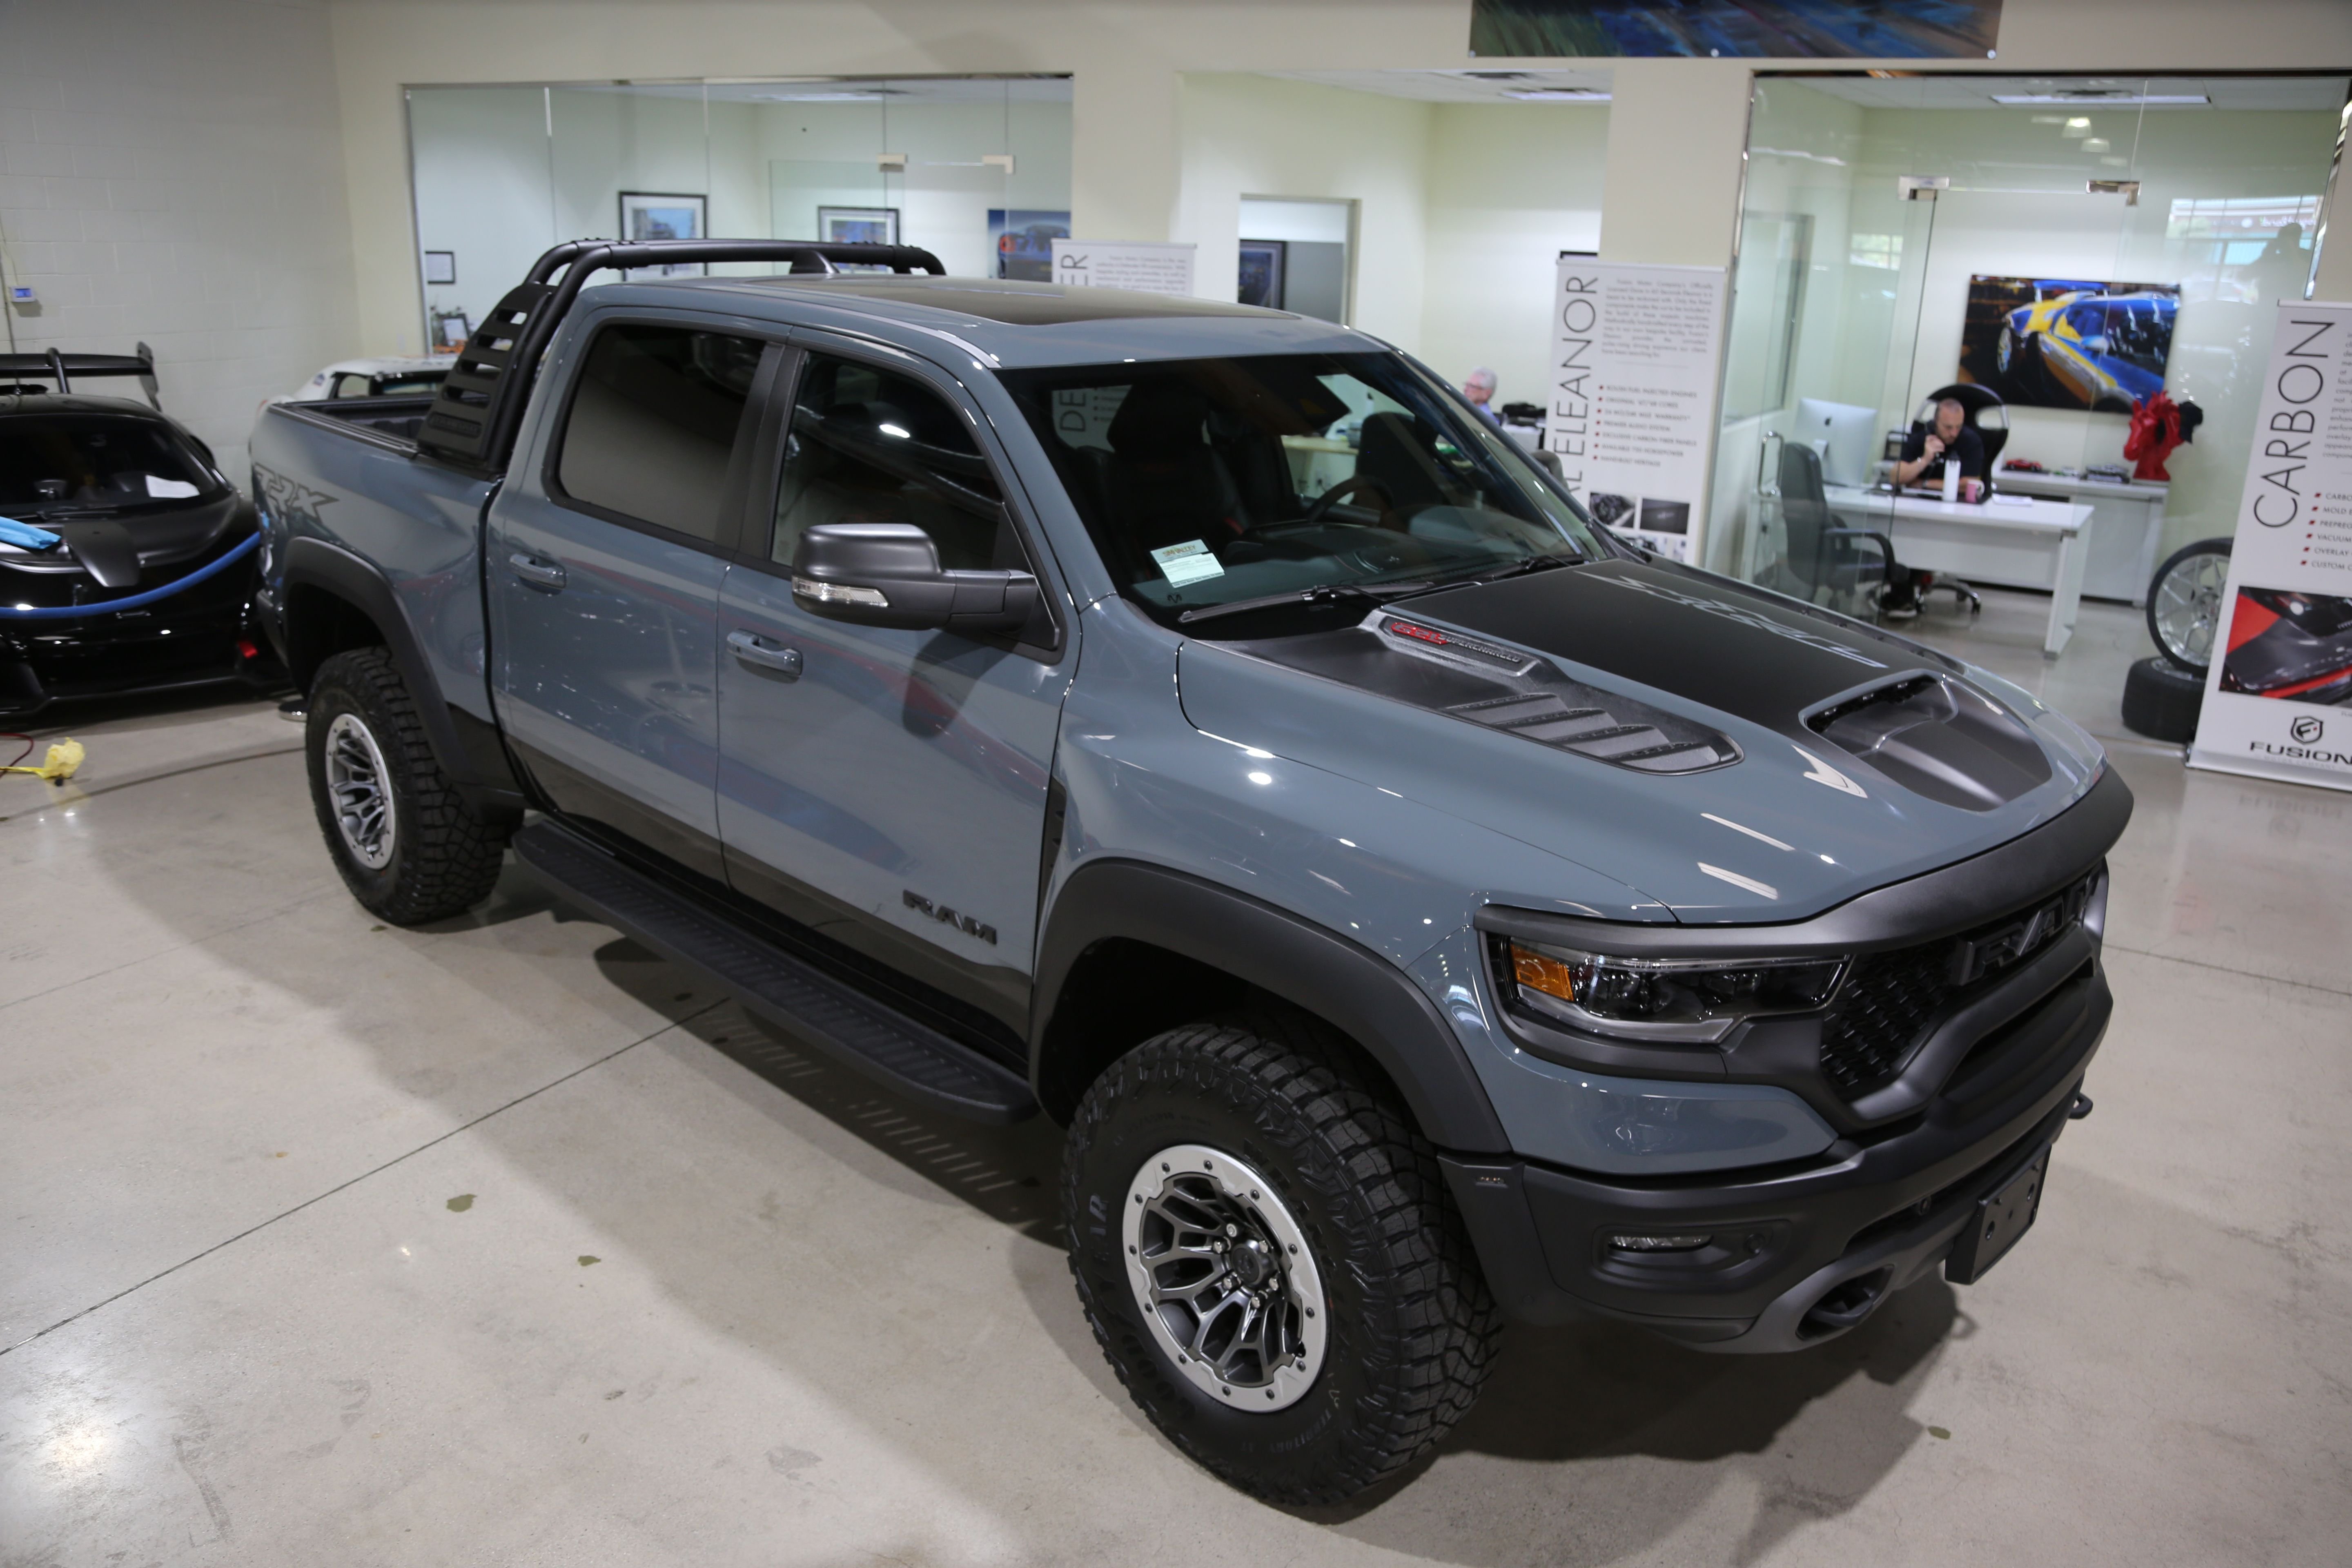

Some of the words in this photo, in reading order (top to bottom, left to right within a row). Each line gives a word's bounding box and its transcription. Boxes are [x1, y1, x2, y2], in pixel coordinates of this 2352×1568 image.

[1555, 277, 1598, 455] ELEANOR
[2253, 320, 2335, 528] CARBON
[2323, 506, 2347, 515] MOLD
[2317, 533, 2352, 543] VACUUM
[1174, 545, 1196, 554] VALLEY
[2314, 547, 2349, 556] OVERLAY
[2312, 560, 2345, 570] CUSTOM
[1437, 634, 1523, 664] SUPERCHARGED
[2250, 742, 2352, 764] FUSION
[903, 889, 998, 946] RAM
